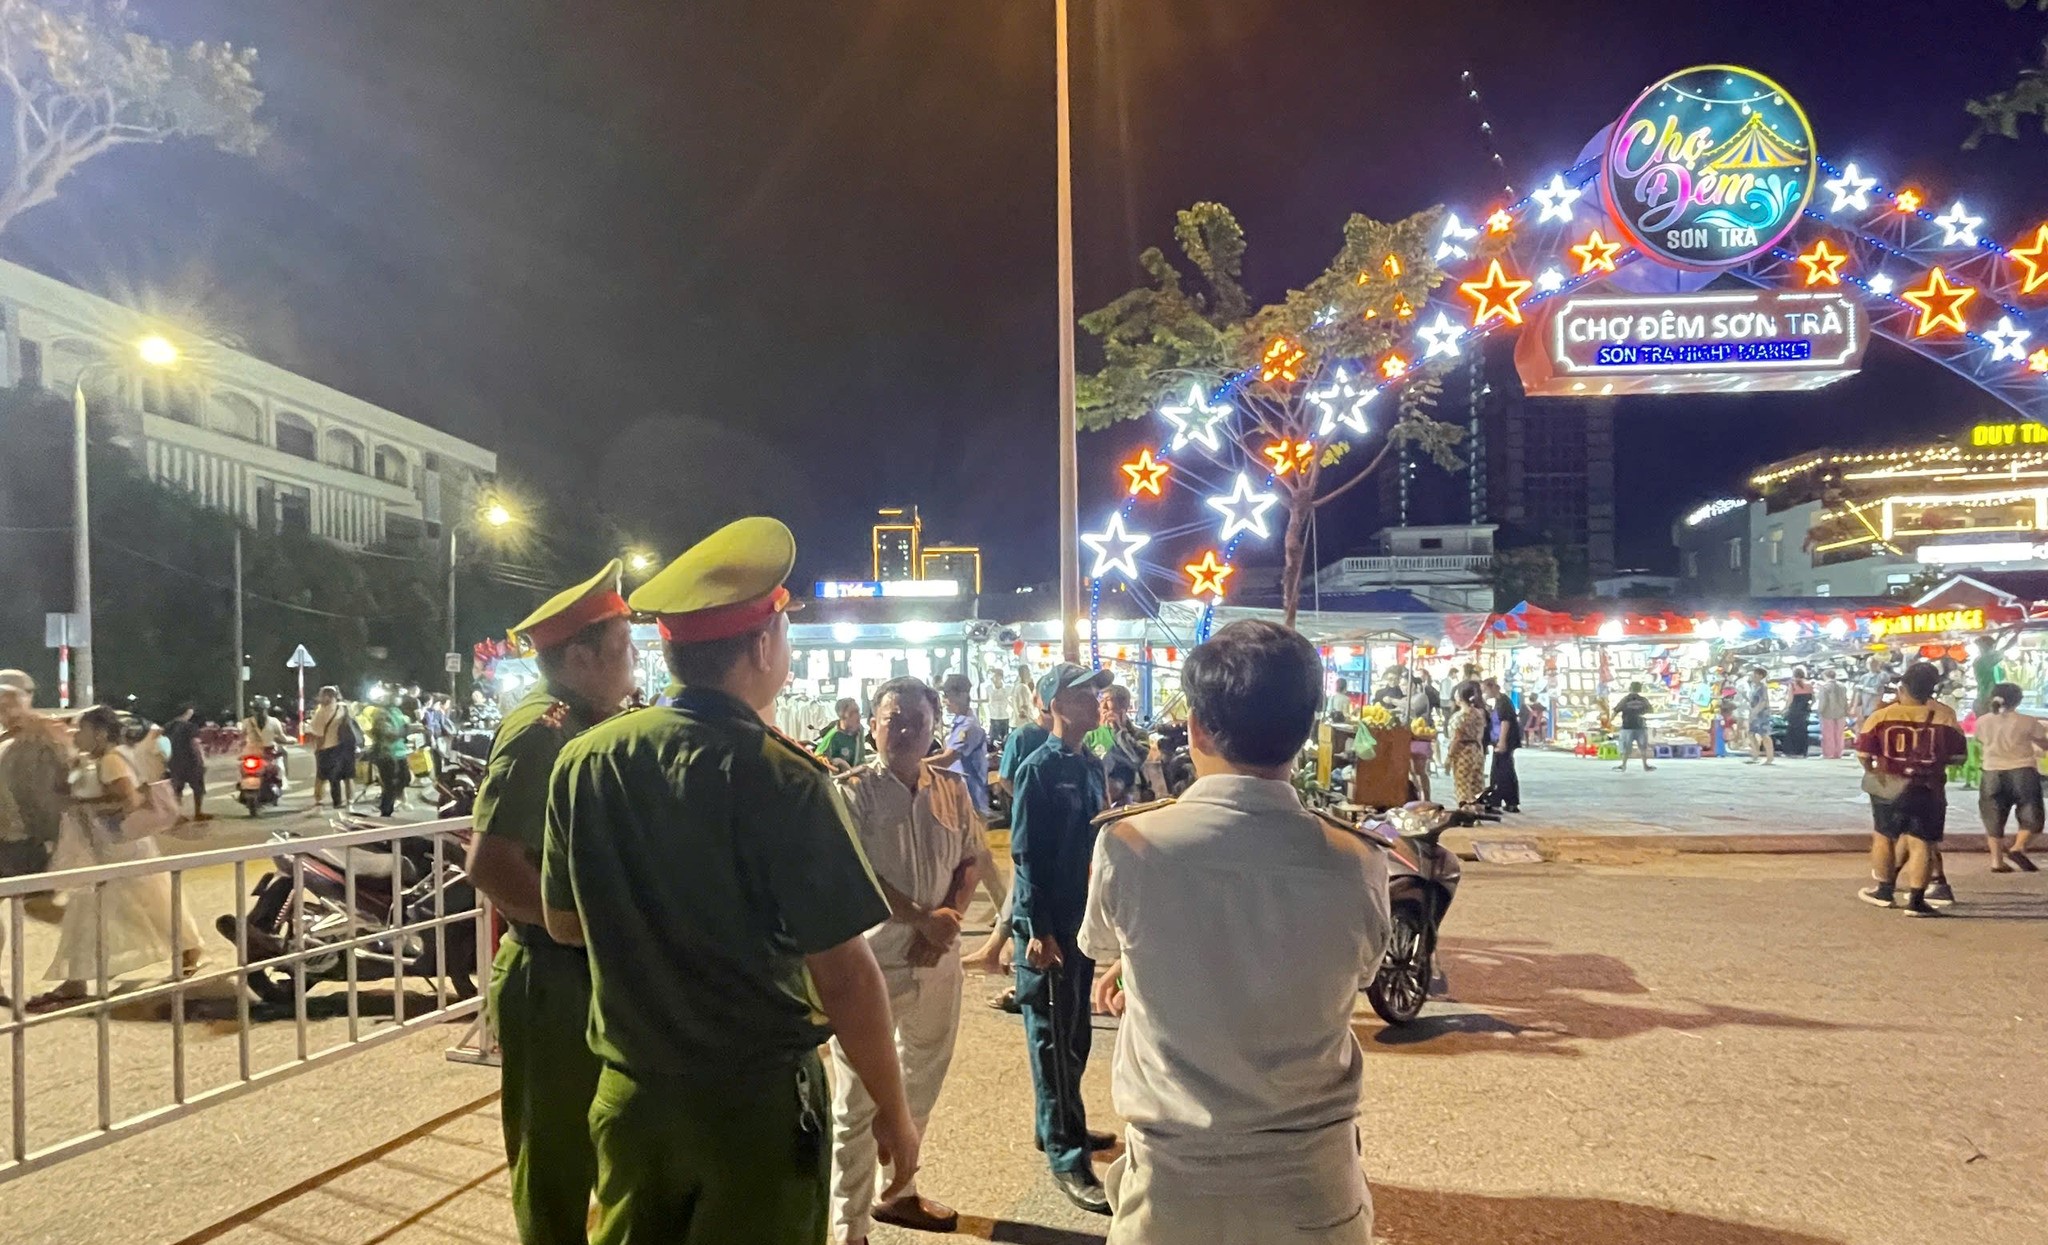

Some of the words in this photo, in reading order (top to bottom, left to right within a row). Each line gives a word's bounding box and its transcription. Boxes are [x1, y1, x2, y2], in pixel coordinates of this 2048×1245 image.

[1614, 115, 1714, 178] Chợ
[1635, 163, 1755, 232] Đêm
[1569, 315, 1634, 344] CHỢ
[1638, 310, 1704, 340] ĐÊM
[1711, 312, 1777, 339] SƠN
[1785, 305, 1842, 335] TRÀ
